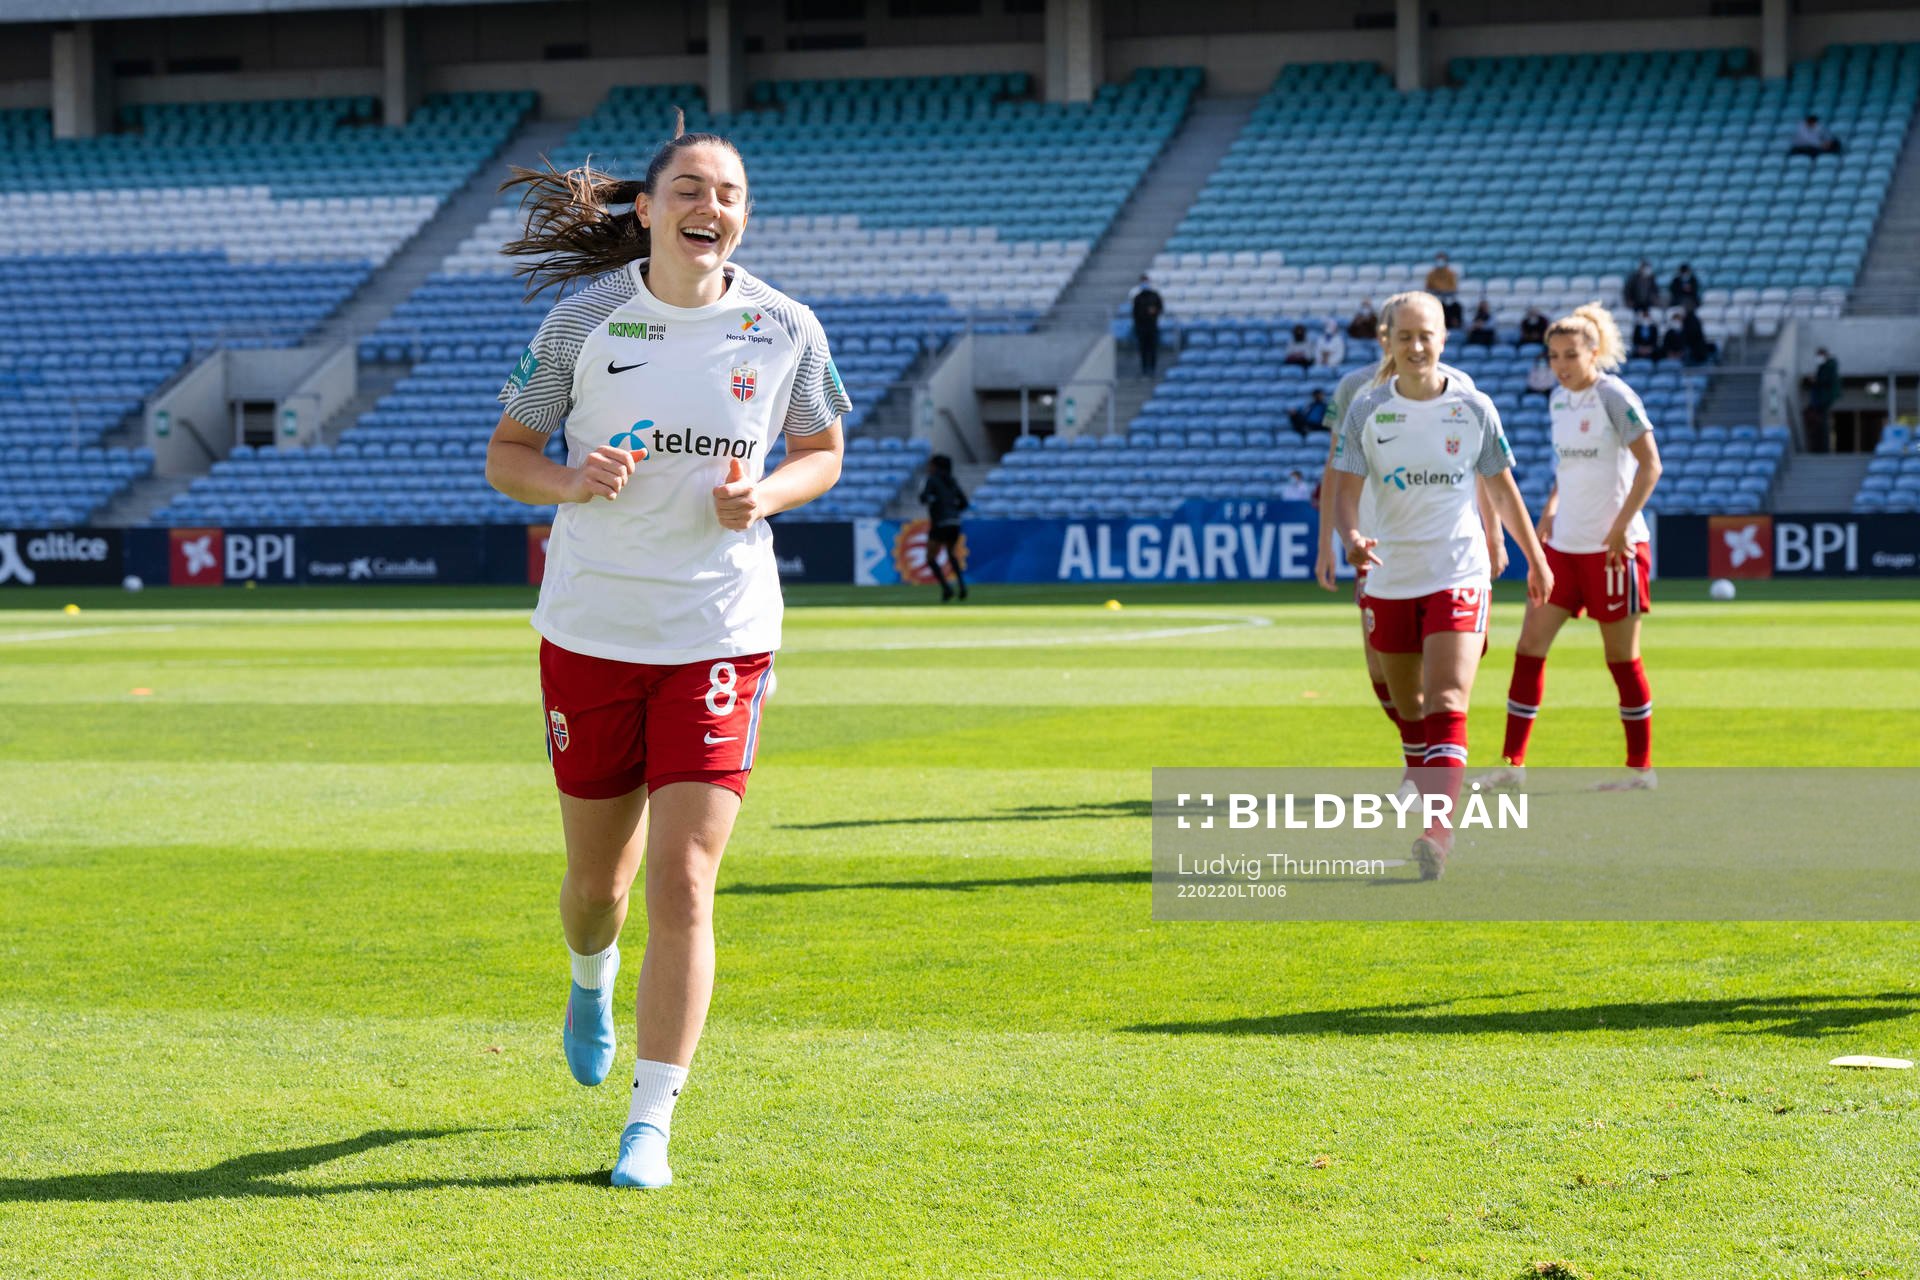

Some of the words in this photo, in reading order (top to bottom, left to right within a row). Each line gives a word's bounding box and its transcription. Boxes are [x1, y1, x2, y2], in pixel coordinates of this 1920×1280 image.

[608, 322, 648, 339] KIWI
[649, 324, 666, 333] mini
[648, 332, 664, 341] pris
[726, 333, 746, 342] Norsk
[748, 335, 773, 345] Tipping
[652, 428, 757, 460] telenor
[27, 531, 109, 561] altice
[225, 533, 295, 579] BPI
[1058, 523, 1310, 579] ALGARVE
[1775, 522, 1858, 572] BPI
[1606, 565, 1625, 597] 11
[705, 661, 738, 717] 8
